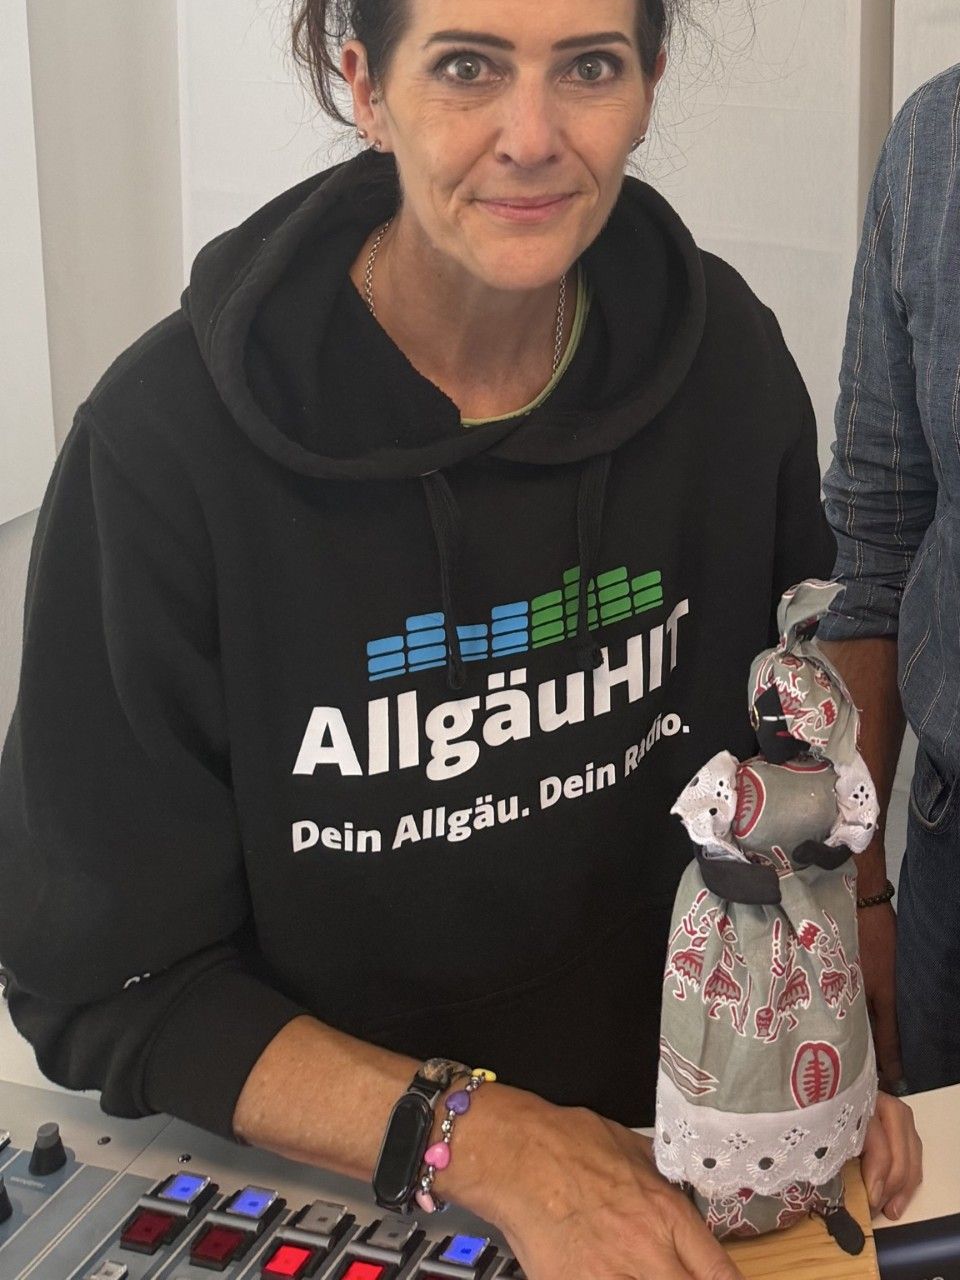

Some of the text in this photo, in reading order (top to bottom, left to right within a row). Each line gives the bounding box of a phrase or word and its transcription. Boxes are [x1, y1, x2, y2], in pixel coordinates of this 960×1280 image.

[292, 598, 690, 782] AllgäuHIT
[292, 712, 690, 853] Dein Allgäu. Dein Radio.
